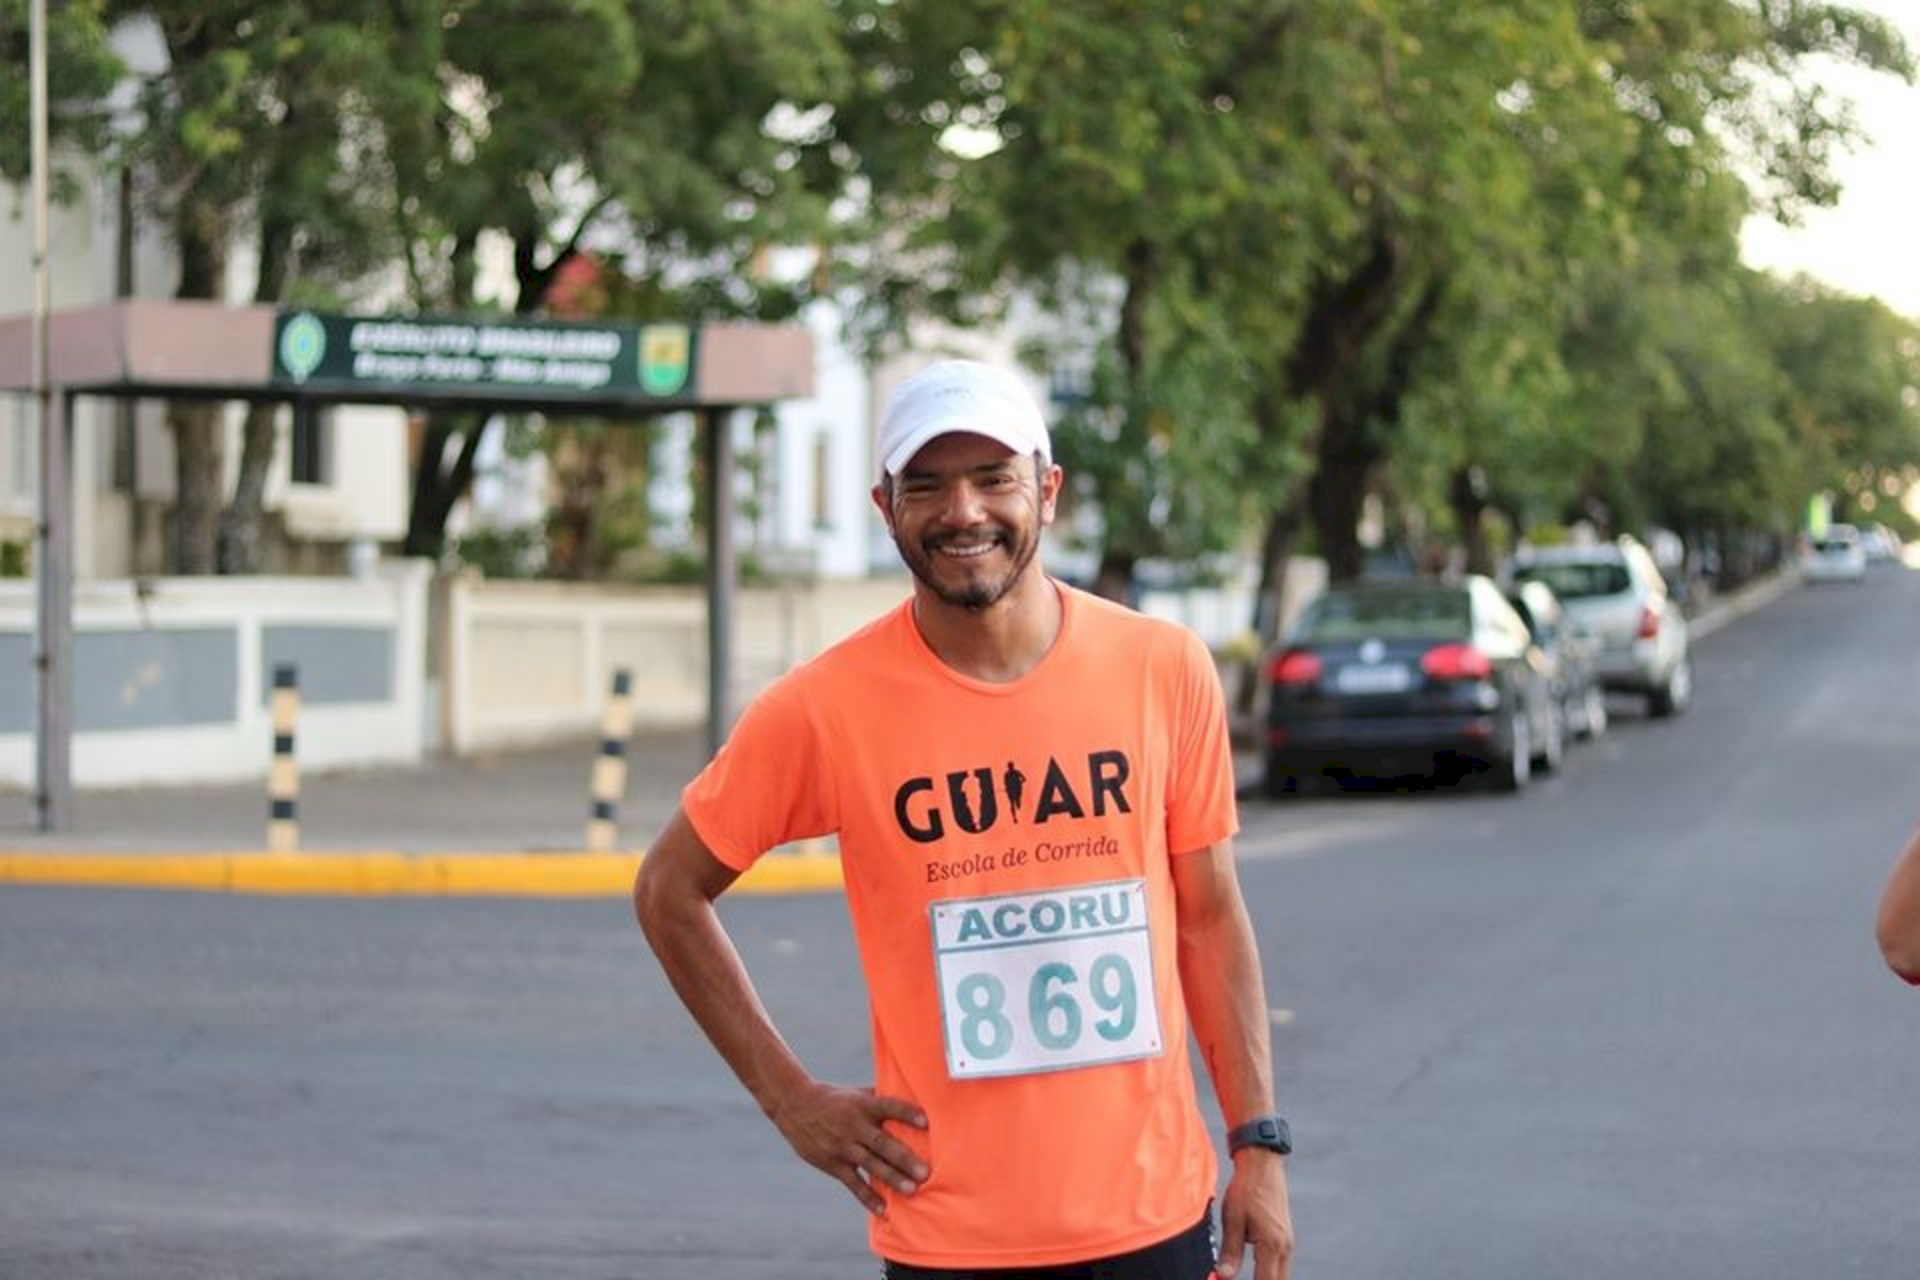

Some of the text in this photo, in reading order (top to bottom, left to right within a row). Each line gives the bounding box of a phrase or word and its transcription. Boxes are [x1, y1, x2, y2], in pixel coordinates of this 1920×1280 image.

[926, 836, 1119, 882] Escola de Corrida
[957, 891, 1130, 942] ACORU
[955, 953, 1137, 1060] 869
